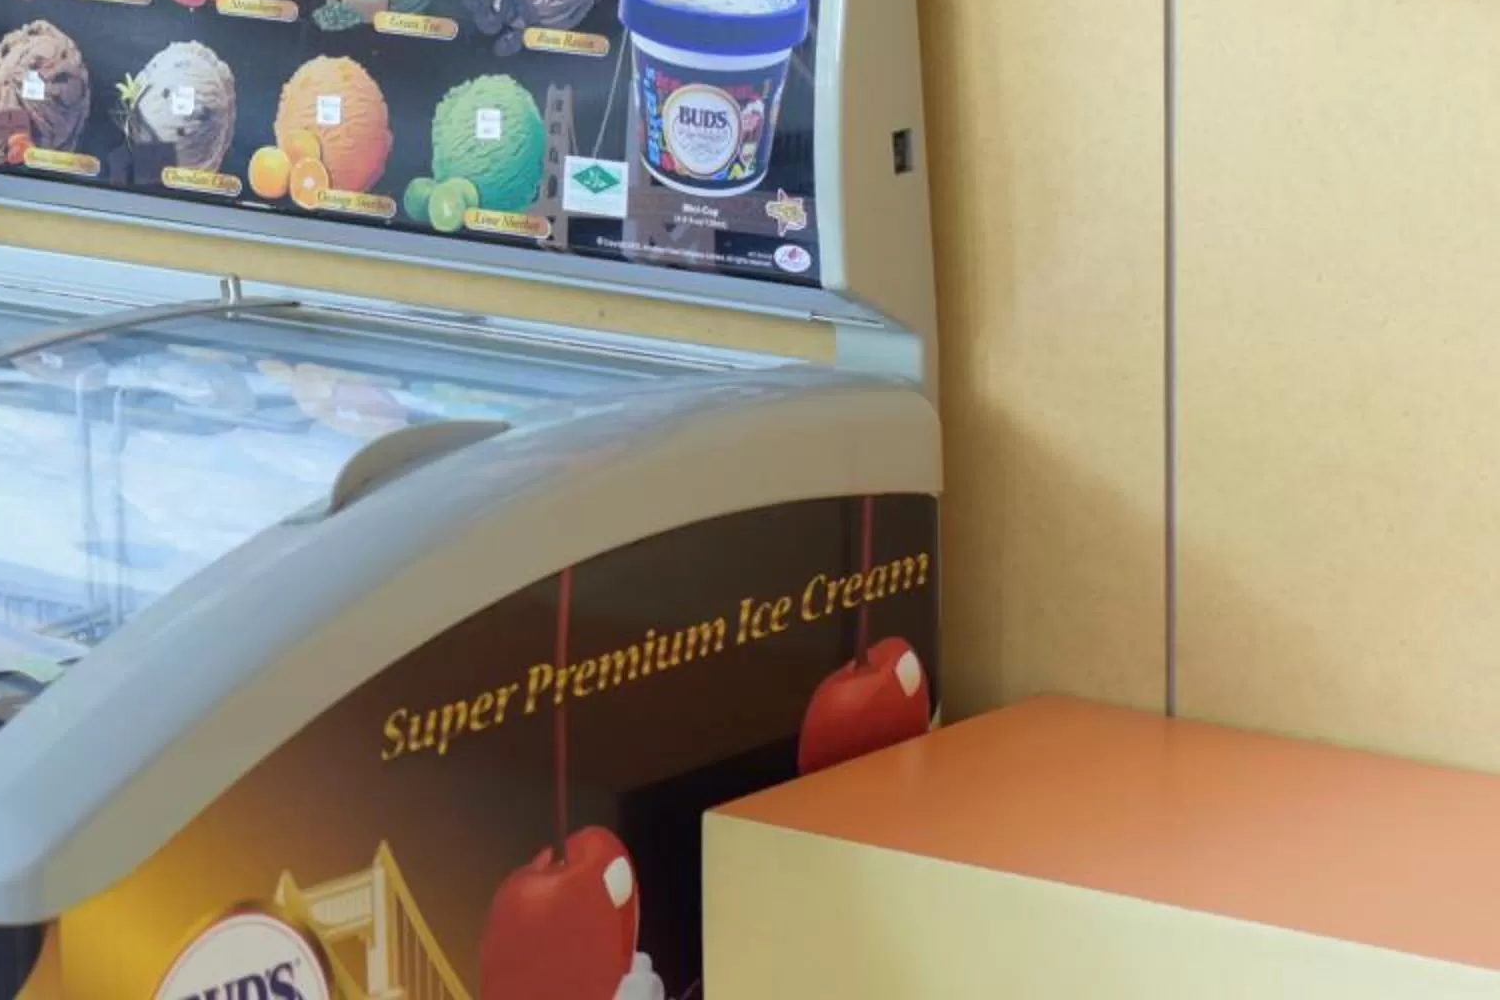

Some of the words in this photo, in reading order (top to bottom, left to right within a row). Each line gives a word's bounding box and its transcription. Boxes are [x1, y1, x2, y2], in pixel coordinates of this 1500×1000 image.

[380, 683, 520, 761] Super
[524, 617, 728, 714] Premium
[736, 590, 793, 650] Ice
[800, 551, 930, 623] Cream
